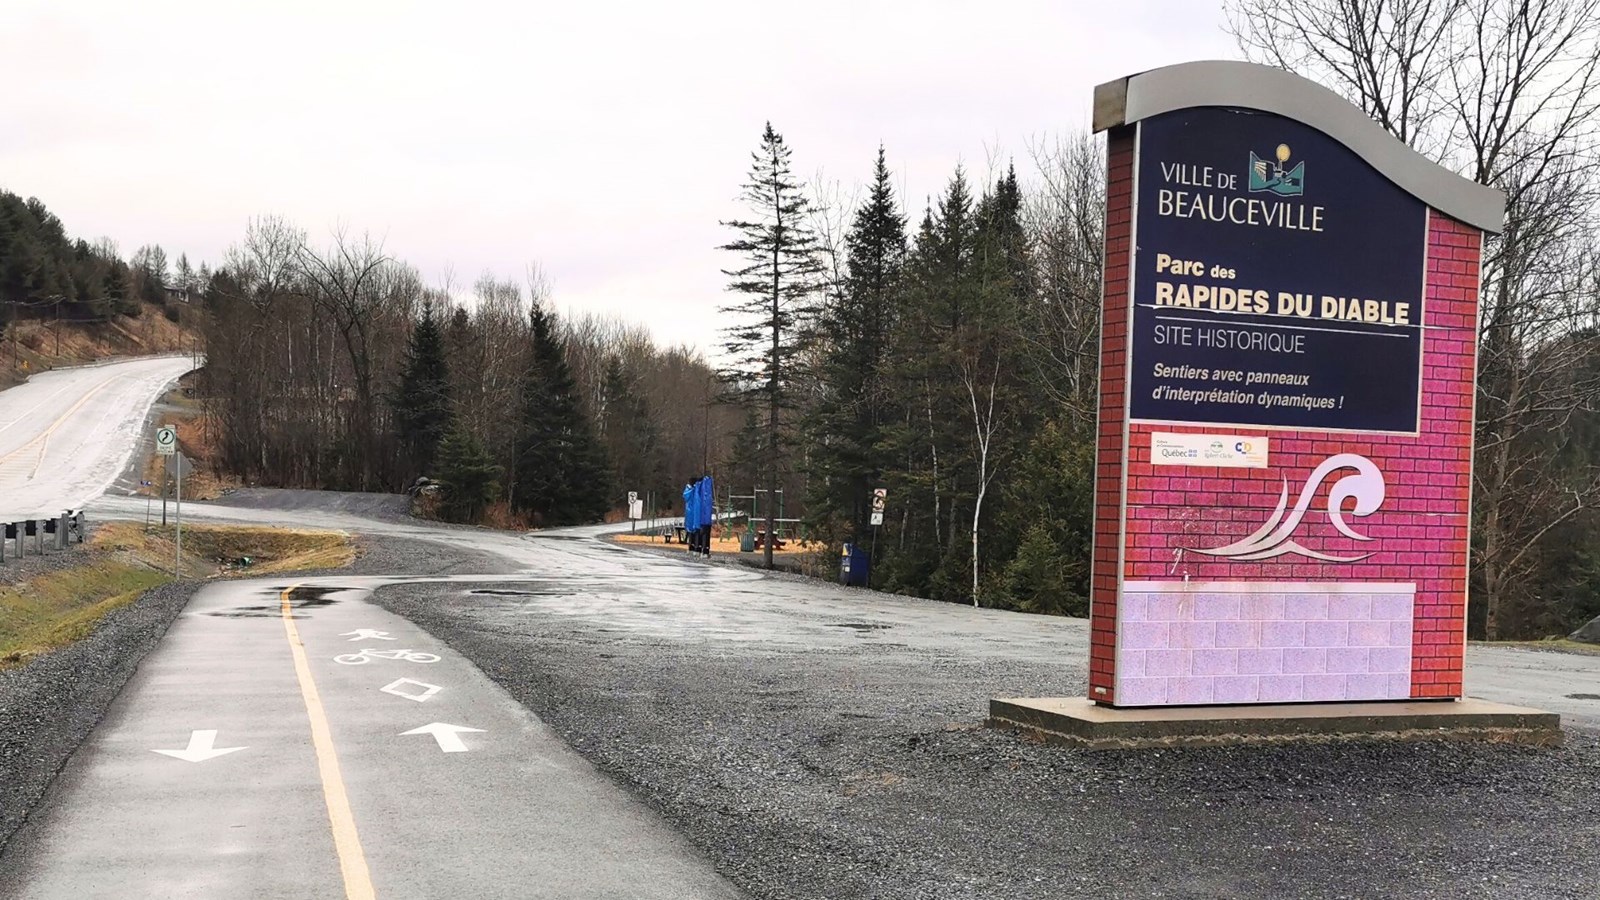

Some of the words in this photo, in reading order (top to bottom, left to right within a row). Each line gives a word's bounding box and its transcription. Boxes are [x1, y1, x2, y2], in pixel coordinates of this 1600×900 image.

[1161, 161, 1213, 188] VILLE
[1217, 172, 1238, 190] DE
[1158, 189, 1325, 232] BEAUCEVILLE
[1156, 253, 1204, 277] Parc
[1210, 264, 1236, 280] des
[1155, 281, 1270, 315] RAPIDES
[1277, 292, 1313, 318] DU
[1321, 296, 1410, 325] DIABLE
[1153, 324, 1193, 347] SITE
[1197, 328, 1305, 354] HISTORIQUE
[1153, 363, 1209, 380] Sentiers
[1212, 367, 1243, 382] avec
[1246, 370, 1310, 386] panneaux
[1257, 391, 1335, 411] dynamiques
[1338, 395, 1344, 409] !
[1161, 448, 1188, 458] Québec
